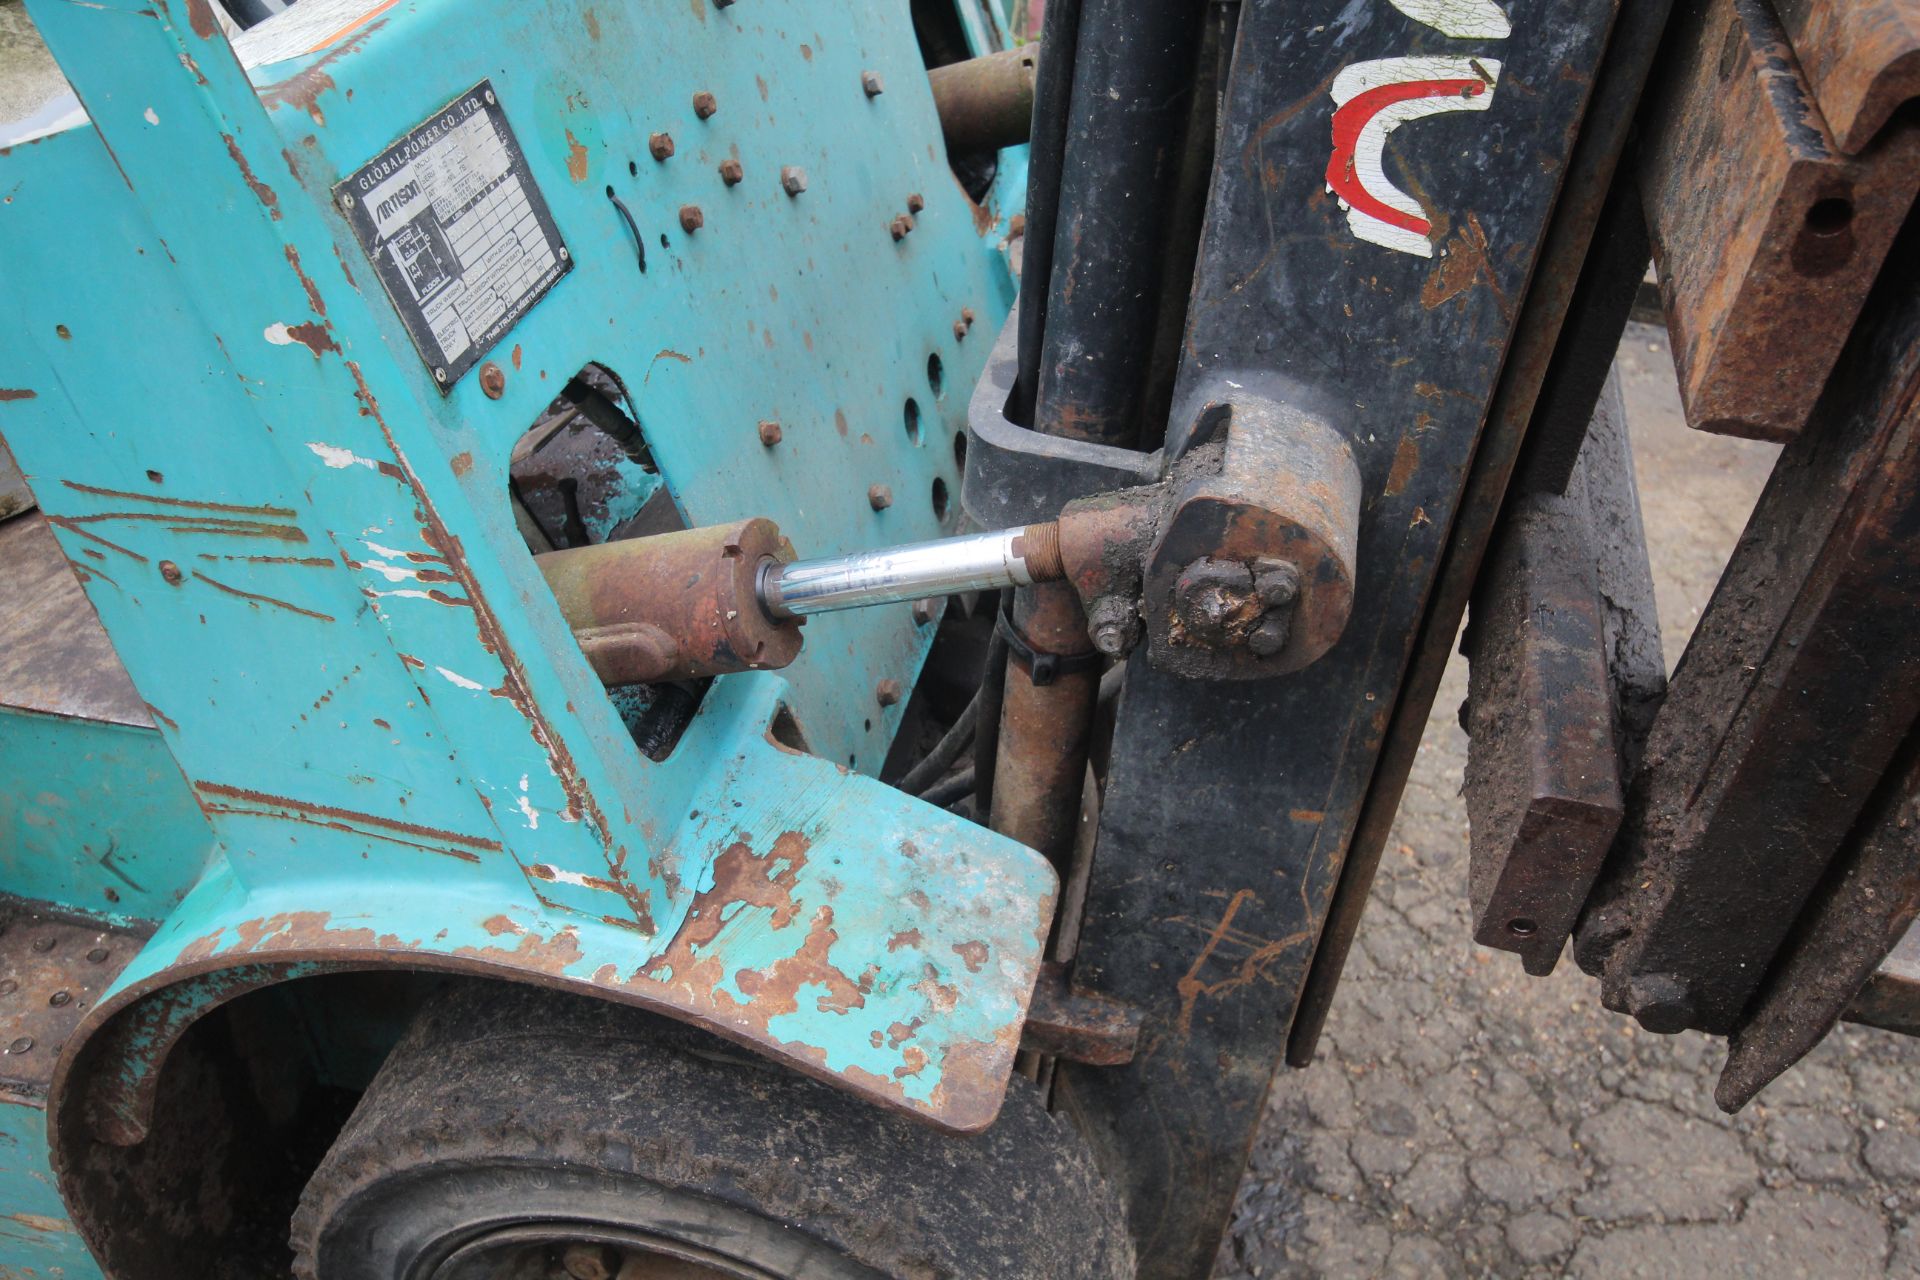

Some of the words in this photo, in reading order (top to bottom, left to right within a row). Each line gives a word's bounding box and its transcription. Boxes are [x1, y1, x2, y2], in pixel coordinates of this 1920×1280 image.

[358, 149, 407, 191] GLOBAL
[402, 124, 440, 158] POWER
[395, 232, 411, 248] LOAD
[421, 275, 441, 295] FLOOR
[426, 299, 443, 317] TRUCK
[442, 283, 462, 303] WEIGHT
[458, 292, 473, 308] TRUCK
[436, 316, 458, 339] ELECTRIC
[485, 324, 500, 341] THIS
[498, 307, 517, 329] TRUCK
[439, 327, 456, 346] TRUCK
[443, 337, 457, 352] ONLY
